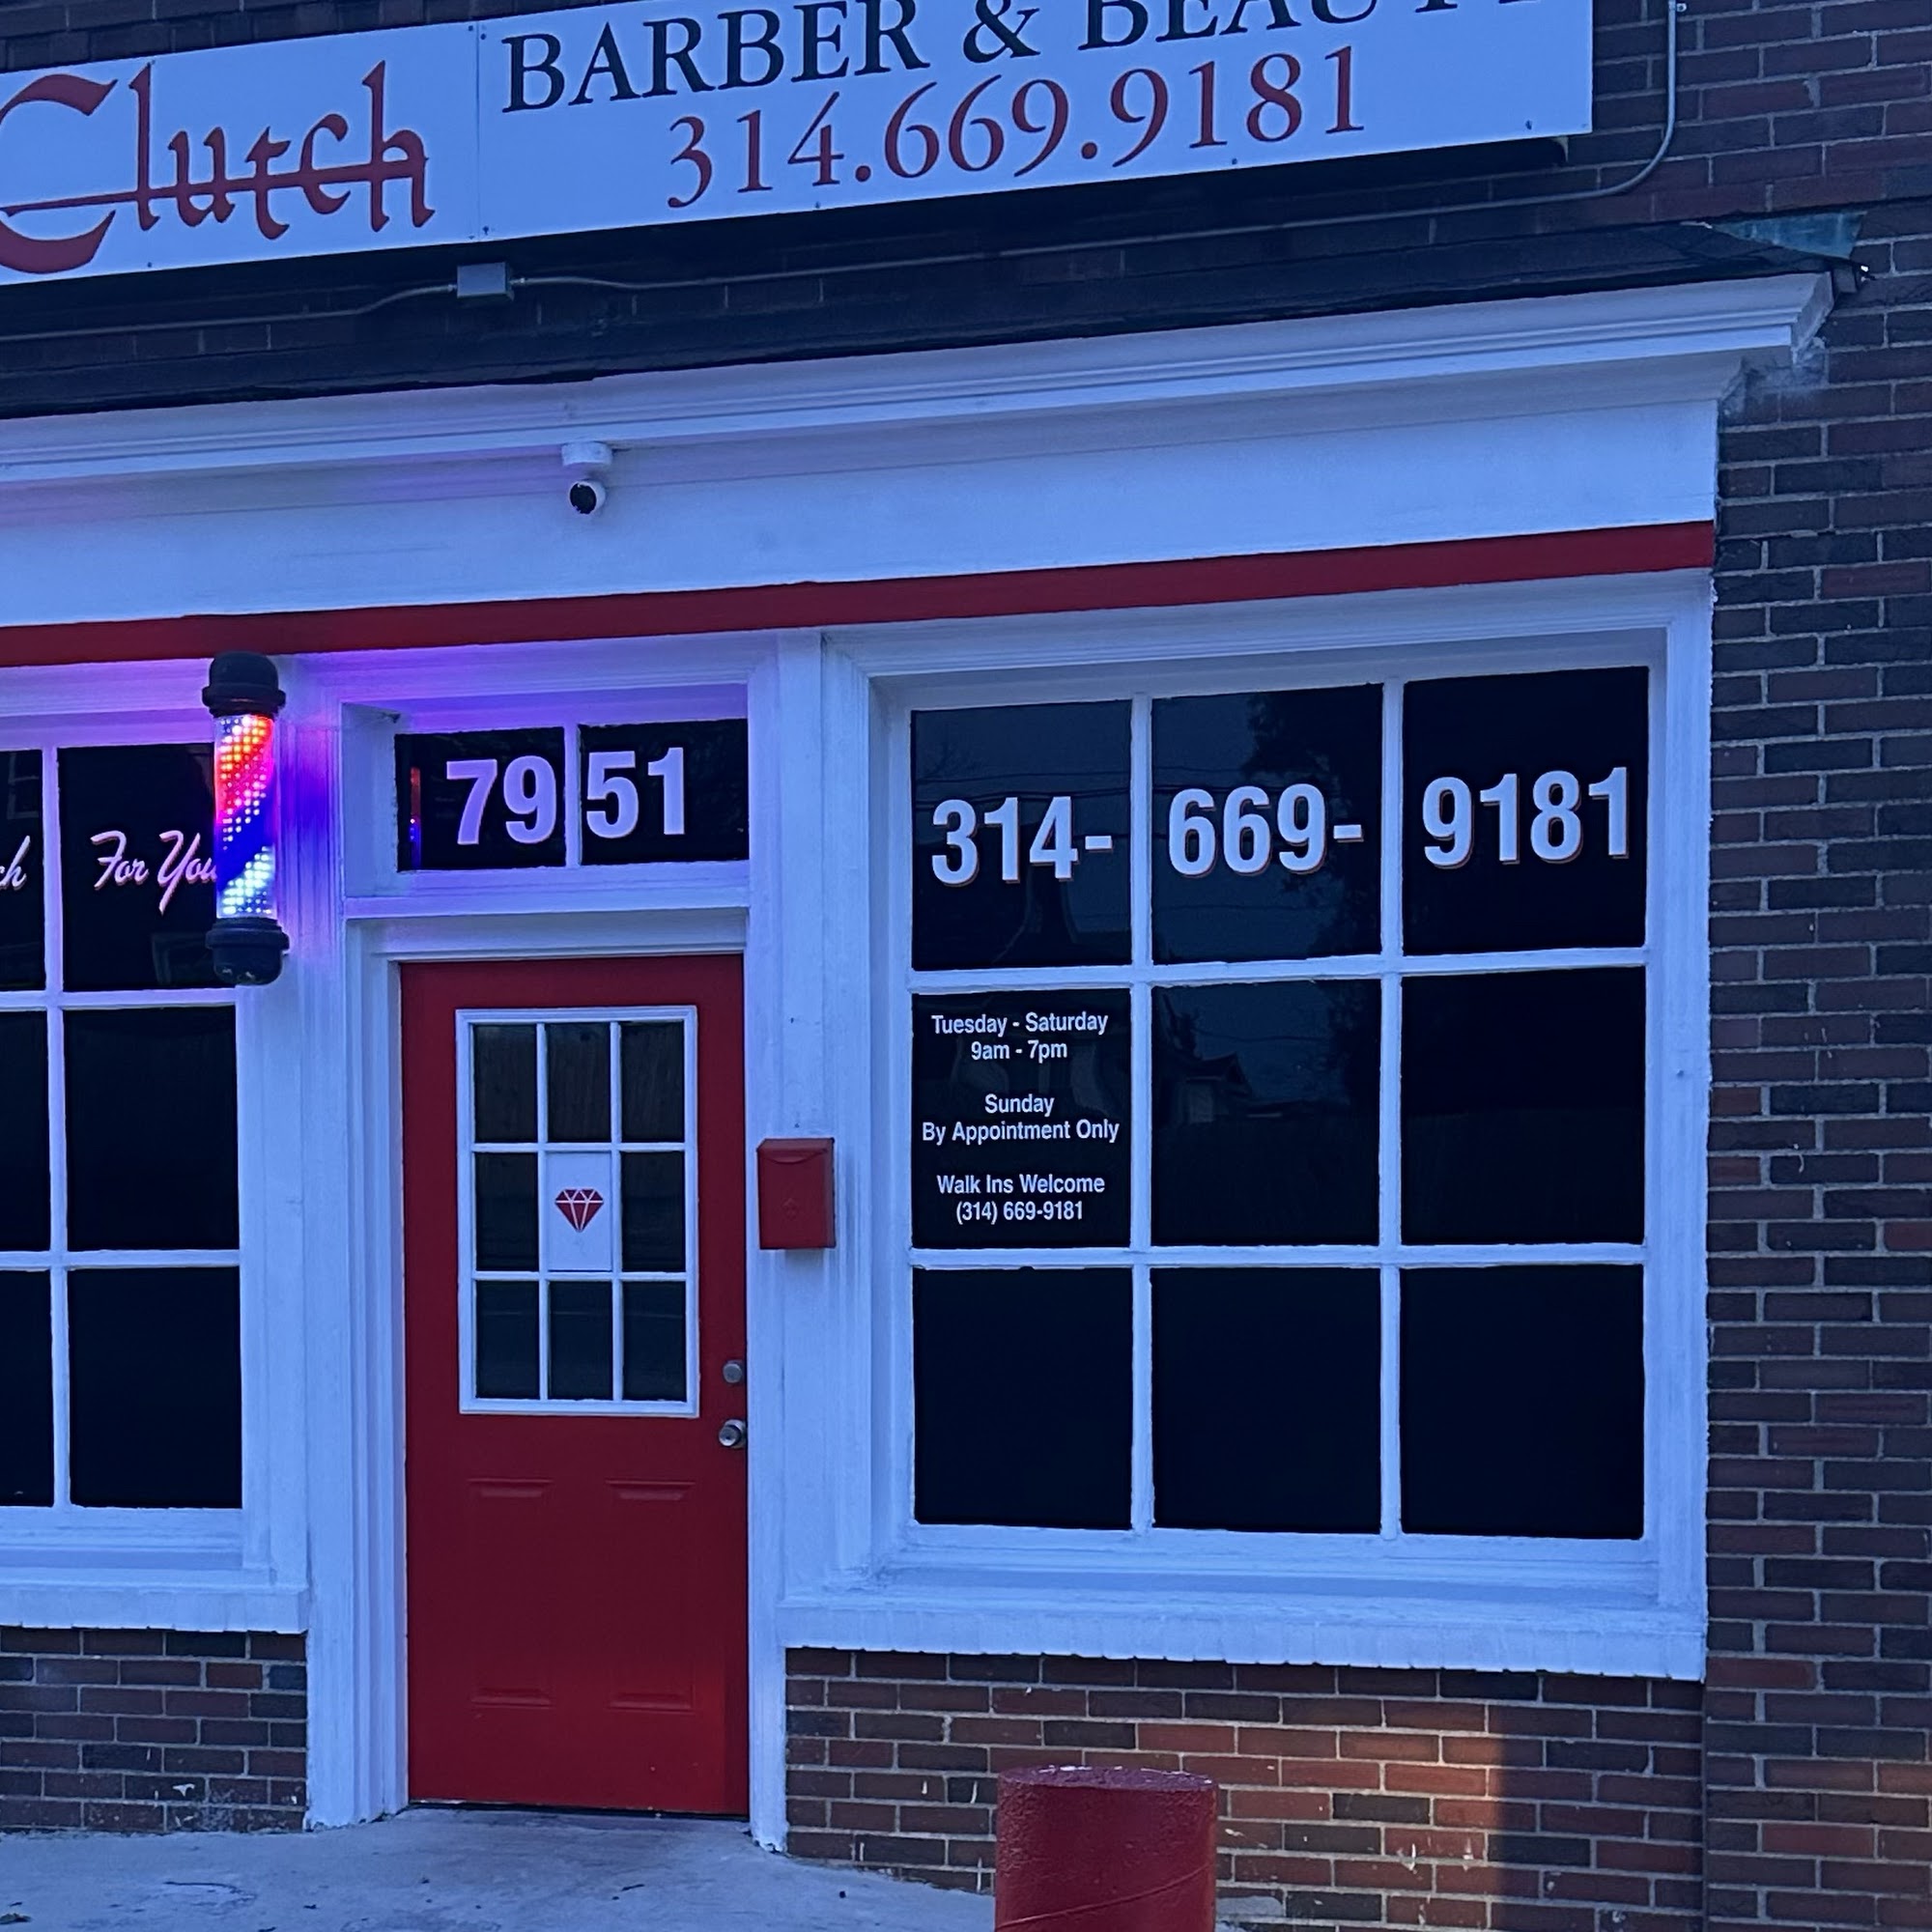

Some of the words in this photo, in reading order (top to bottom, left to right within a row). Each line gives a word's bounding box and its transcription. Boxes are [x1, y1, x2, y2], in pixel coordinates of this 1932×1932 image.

[501, 0, 931, 114] BARBER
[962, 0, 1040, 64] &
[668, 45, 1365, 209] 314.669.9181
[930, 795, 1115, 886] 314-
[1168, 782, 1364, 877] 669-
[1421, 766, 1631, 869] 9181
[90, 830, 150, 891] For
[931, 1013, 1008, 1037] Tuesday
[1025, 1010, 1109, 1035] Saturday
[971, 1040, 1010, 1061] 9am
[1027, 1039, 1068, 1064] 7pm
[984, 1093, 1055, 1117] Sunday
[922, 1121, 946, 1146] By
[952, 1120, 1071, 1146] Appointment
[1075, 1118, 1121, 1143] Only
[936, 1174, 981, 1194] Walk
[986, 1174, 1014, 1194] Ins
[1019, 1173, 1106, 1193] Welcome
[955, 1201, 998, 1225] (314)
[1003, 1200, 1083, 1220] 669-9181
